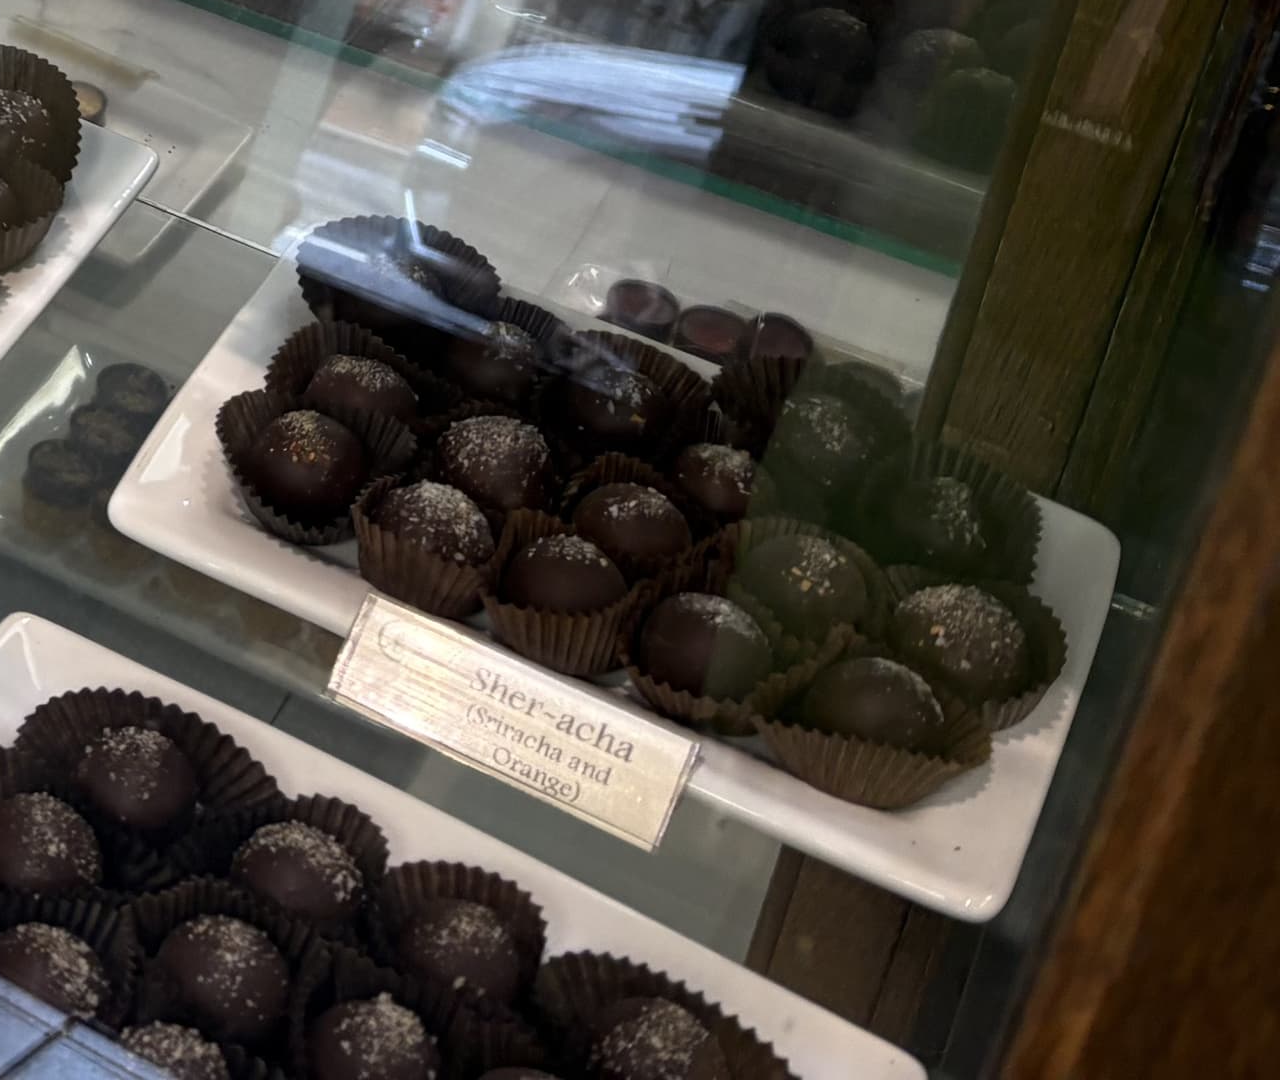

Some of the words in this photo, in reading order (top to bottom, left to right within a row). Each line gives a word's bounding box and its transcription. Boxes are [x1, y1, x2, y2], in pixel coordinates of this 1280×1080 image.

[465, 702, 565, 762] (Sriracha
[567, 754, 614, 787] and
[491, 746, 583, 803] Orange)
